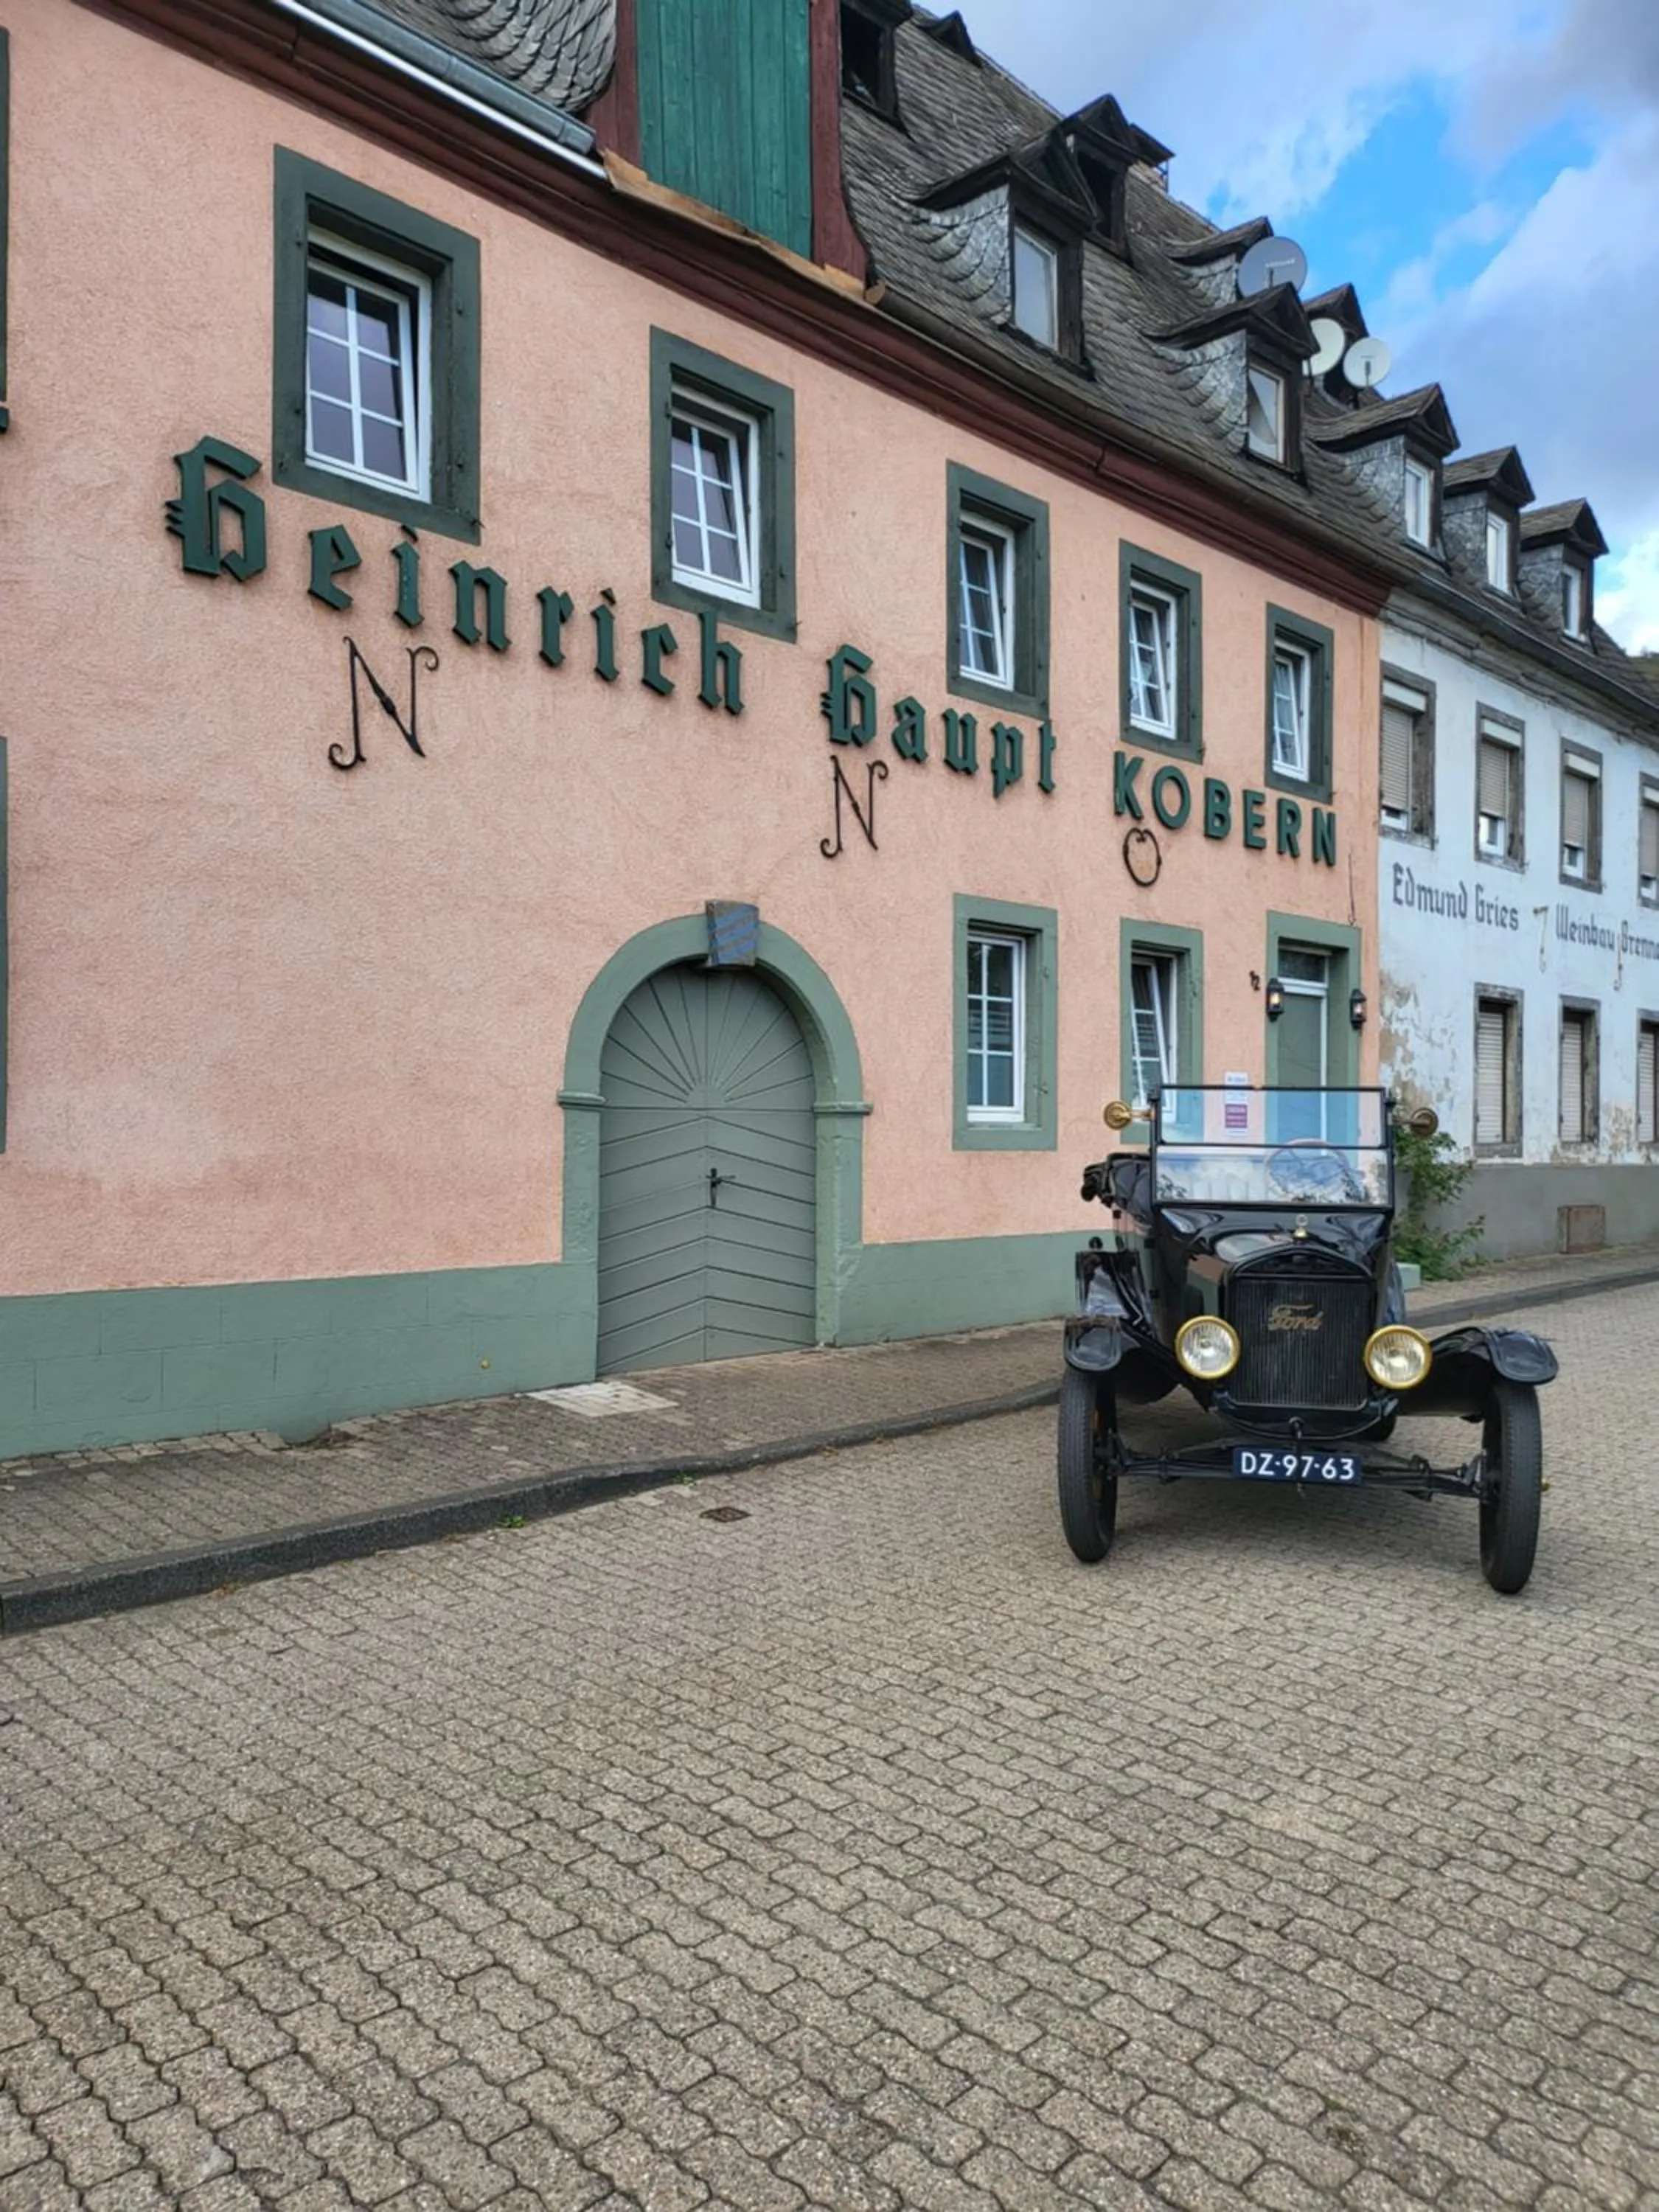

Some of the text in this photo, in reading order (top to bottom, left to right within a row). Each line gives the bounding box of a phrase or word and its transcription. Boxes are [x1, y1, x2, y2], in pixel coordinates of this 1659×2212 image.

[165, 435, 1337, 867] Heinrich Haupt KOBERN
[1392, 861, 1469, 920] Edmund
[1474, 883, 1520, 931] Gries
[1555, 903, 1615, 952] Weinbau
[1267, 1303, 1324, 1332] Ford
[1240, 1451, 1354, 1481] DZ-97-63
